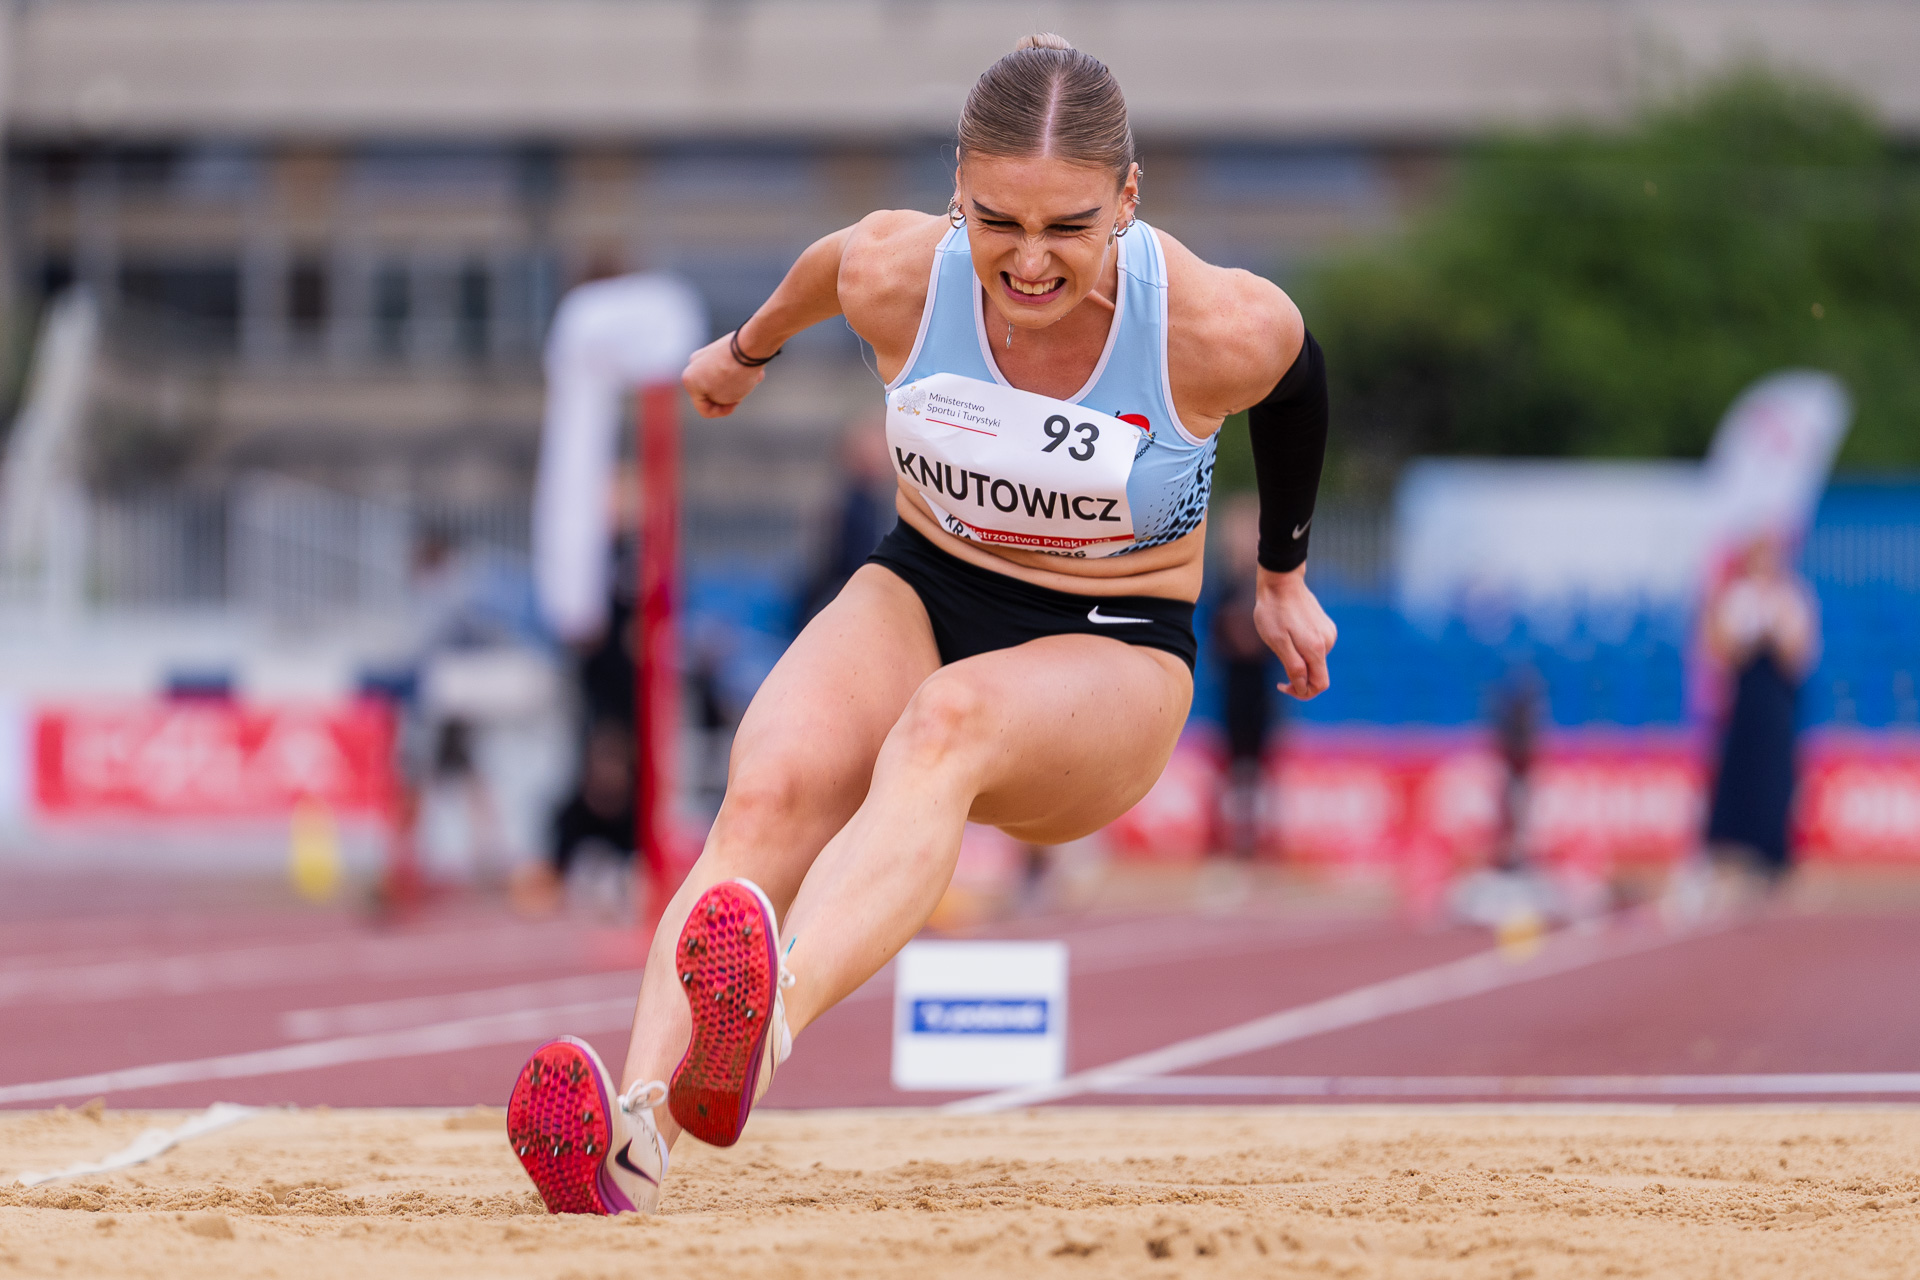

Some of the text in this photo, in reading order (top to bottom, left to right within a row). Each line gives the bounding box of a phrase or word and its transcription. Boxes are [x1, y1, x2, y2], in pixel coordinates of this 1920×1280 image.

[929, 392, 985, 413] Ministerstwo
[926, 403, 956, 417] Sportu
[963, 411, 1001, 428] Turystyki
[1041, 414, 1100, 462] 93
[895, 446, 1121, 522] KNUTOWICZ
[1043, 538, 1082, 549] Polski
